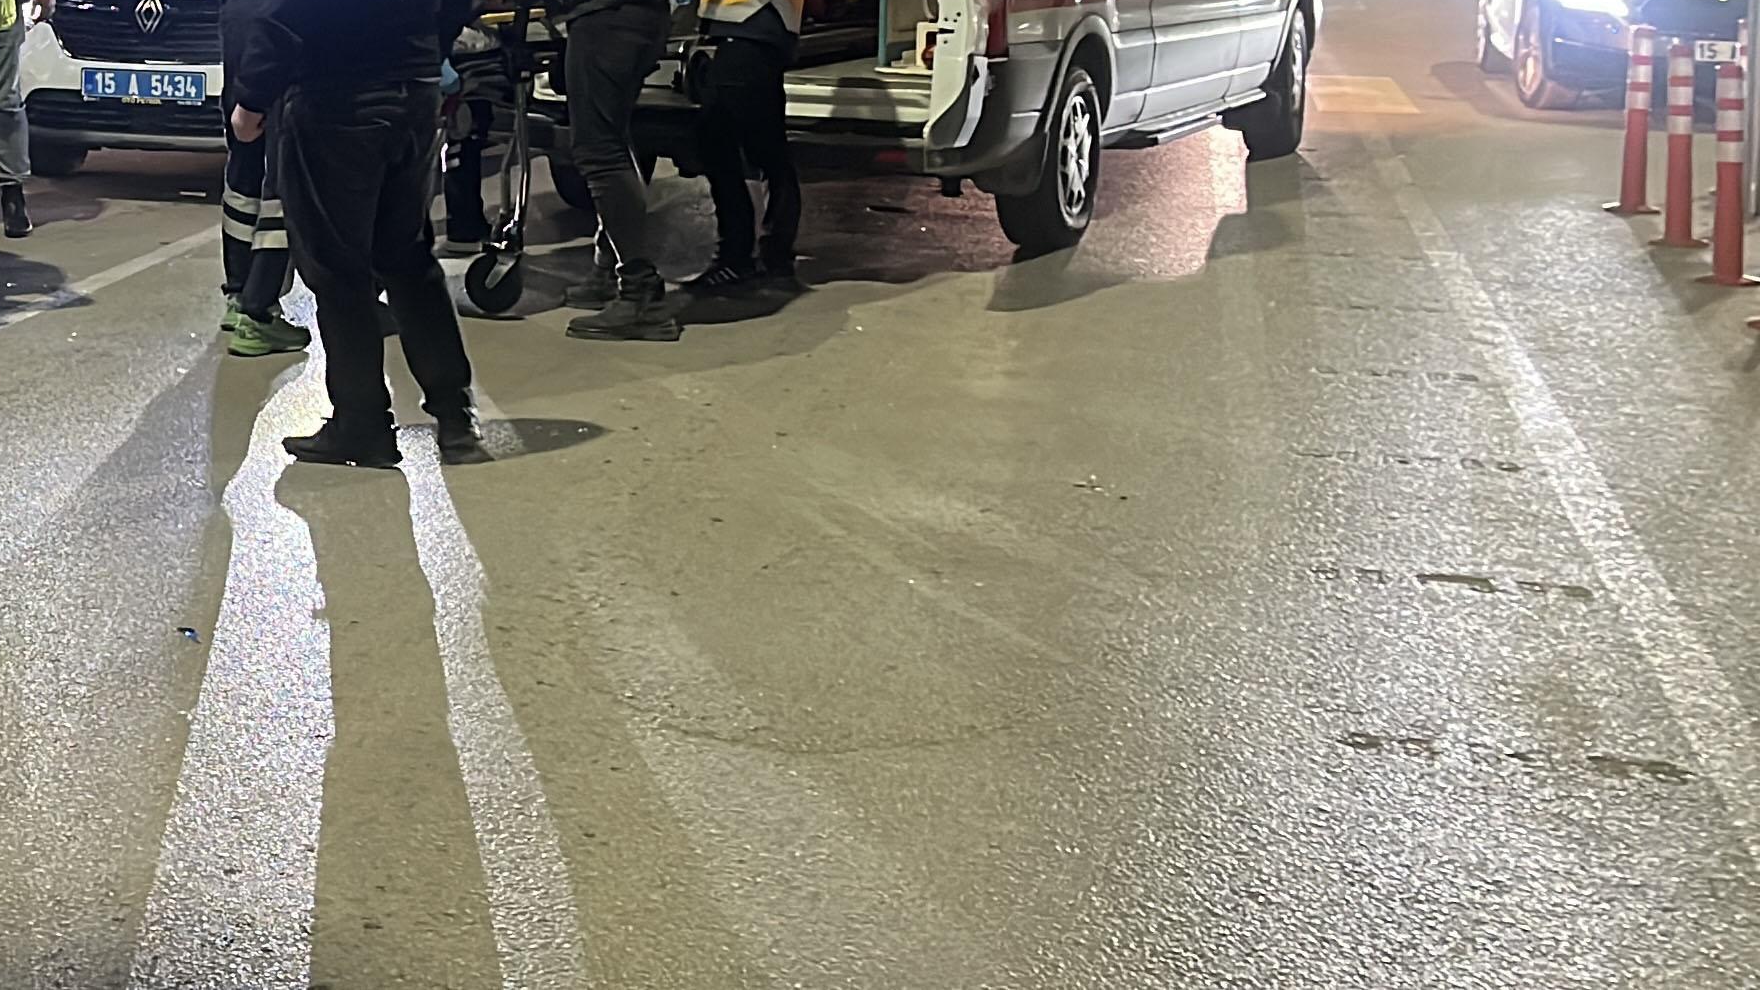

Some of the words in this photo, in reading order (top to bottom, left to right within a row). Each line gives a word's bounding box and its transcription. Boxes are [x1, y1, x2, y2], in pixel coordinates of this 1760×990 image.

[95, 72, 116, 94] 15
[128, 73, 139, 95] A
[151, 73, 197, 98] 5434
